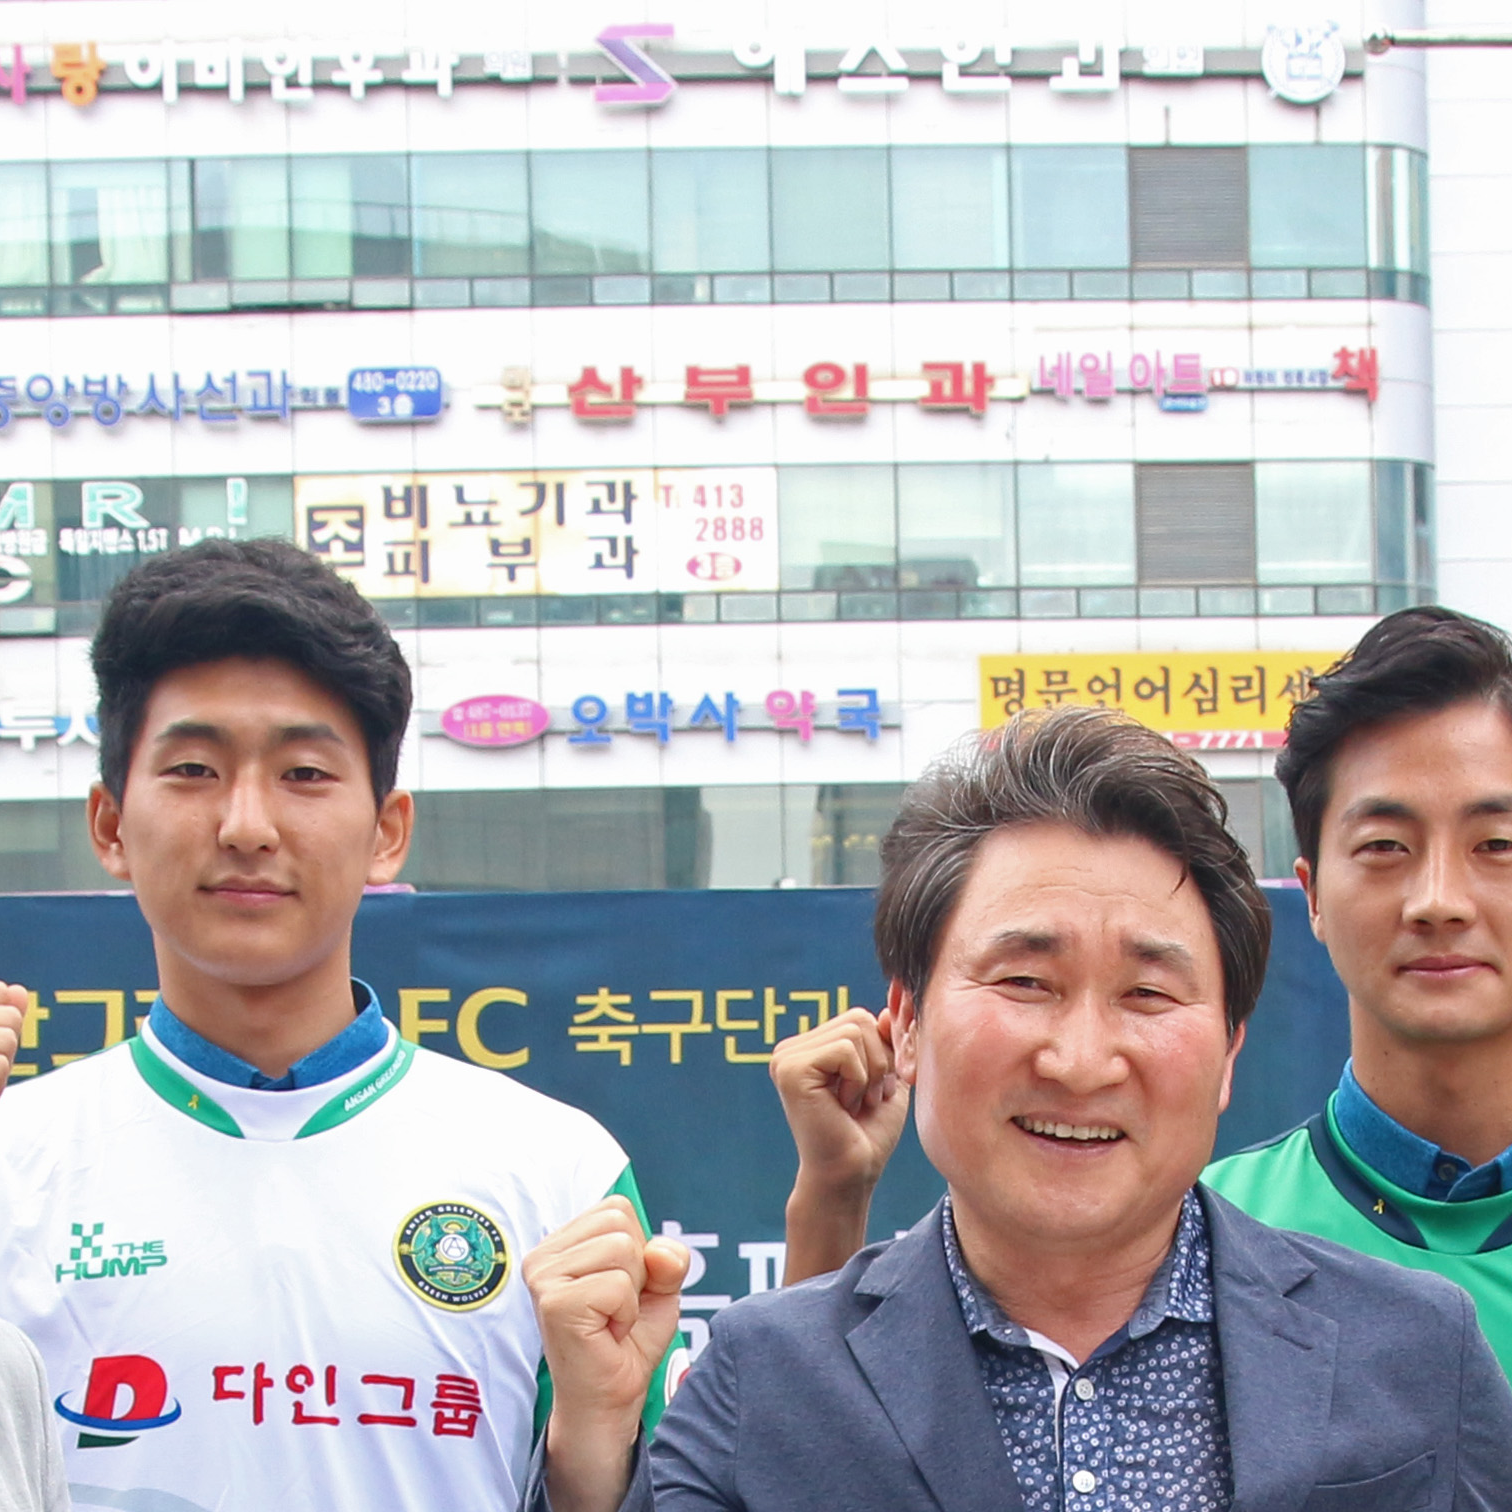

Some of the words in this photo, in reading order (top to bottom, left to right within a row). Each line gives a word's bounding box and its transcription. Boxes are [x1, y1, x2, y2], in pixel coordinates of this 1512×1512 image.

[567, 361, 996, 420] 산부인과
[1039, 350, 1116, 398] 네일
[1128, 348, 1207, 397] 아트
[1331, 346, 1379, 403] 책
[381, 481, 638, 531] 비뇨기과
[692, 482, 745, 509] 413
[695, 516, 765, 542] 2888
[381, 534, 638, 585] 피부과
[397, 988, 529, 1069] FC
[344, 1083, 378, 1112] ANSAN
[55, 1255, 169, 1285] HUMP
[111, 1239, 165, 1256] THE
[211, 1361, 485, 1440] 다인그룹
